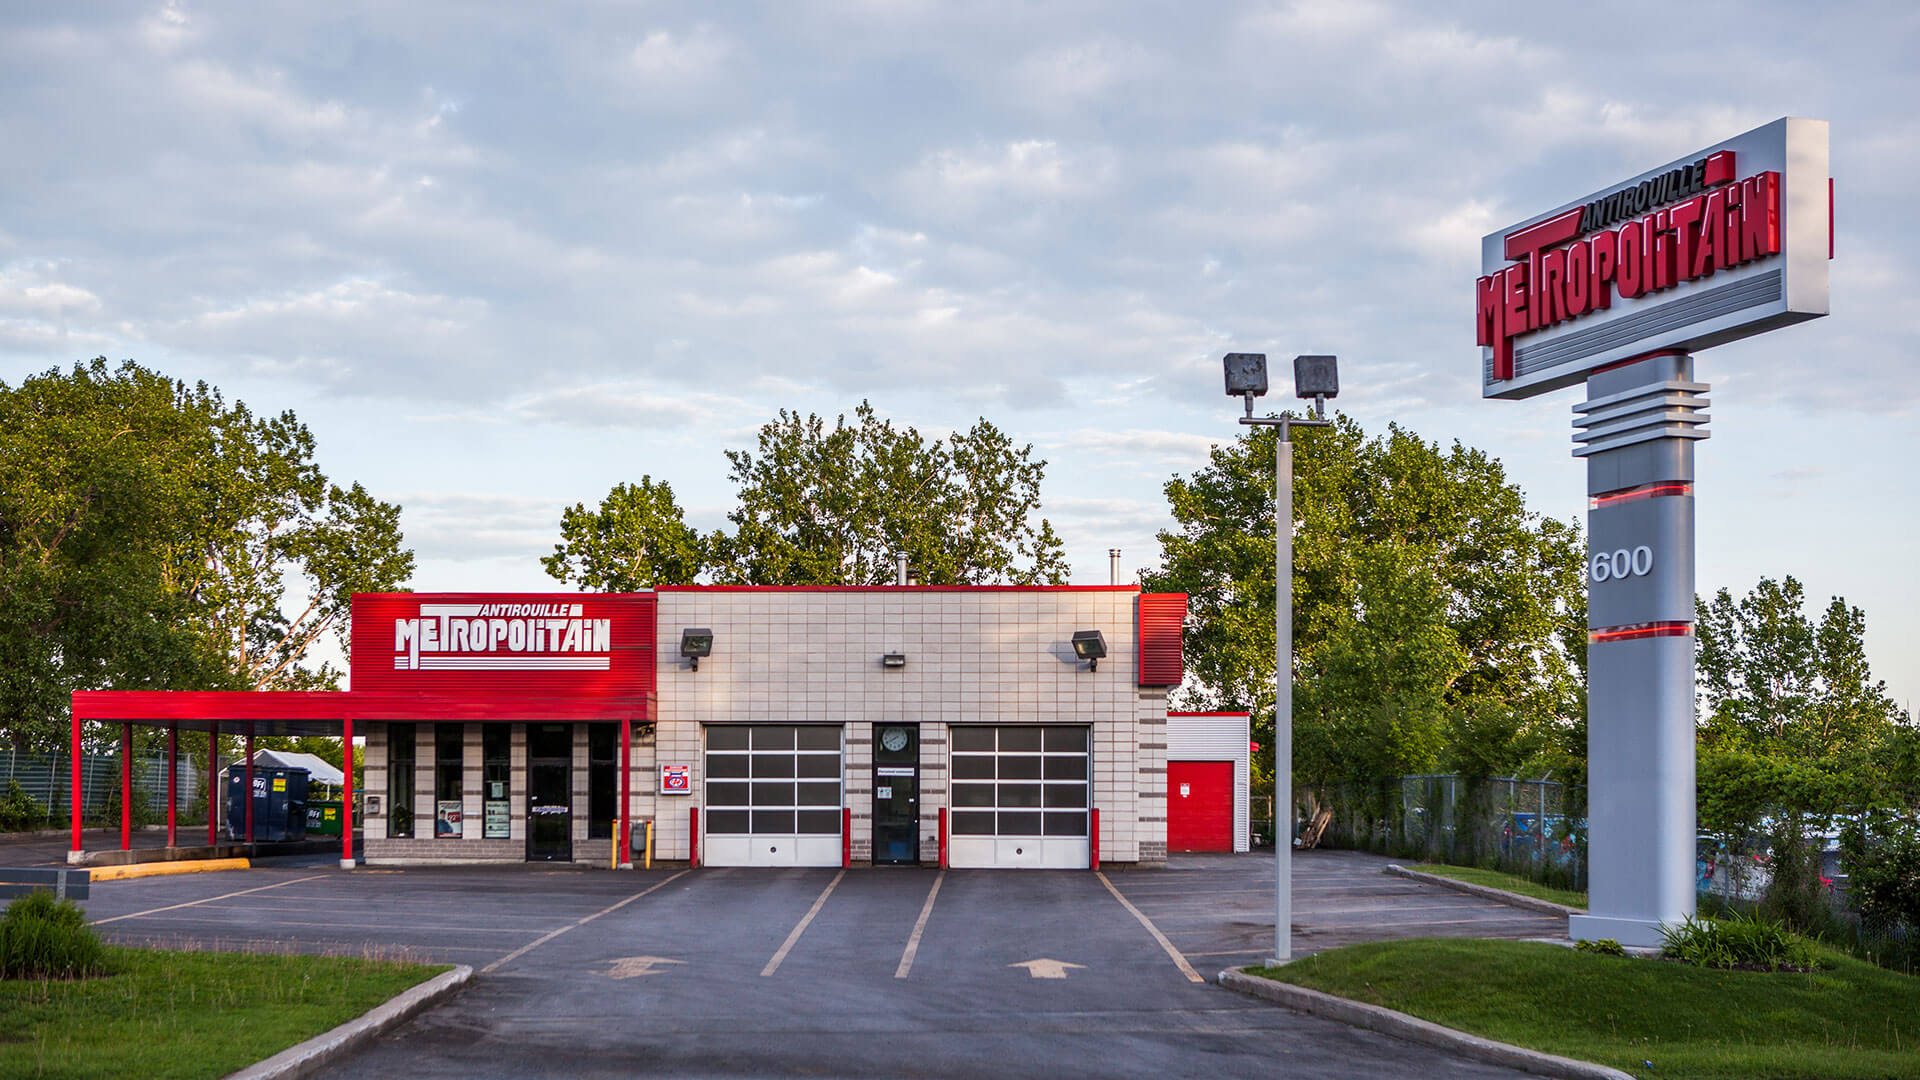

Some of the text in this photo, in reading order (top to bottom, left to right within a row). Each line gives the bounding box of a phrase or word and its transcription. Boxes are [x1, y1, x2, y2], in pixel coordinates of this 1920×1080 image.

[1579, 159, 1708, 233] ANTIROUILLE
[1591, 545, 1653, 583] 600
[480, 603, 570, 617] ANTIROUILLE
